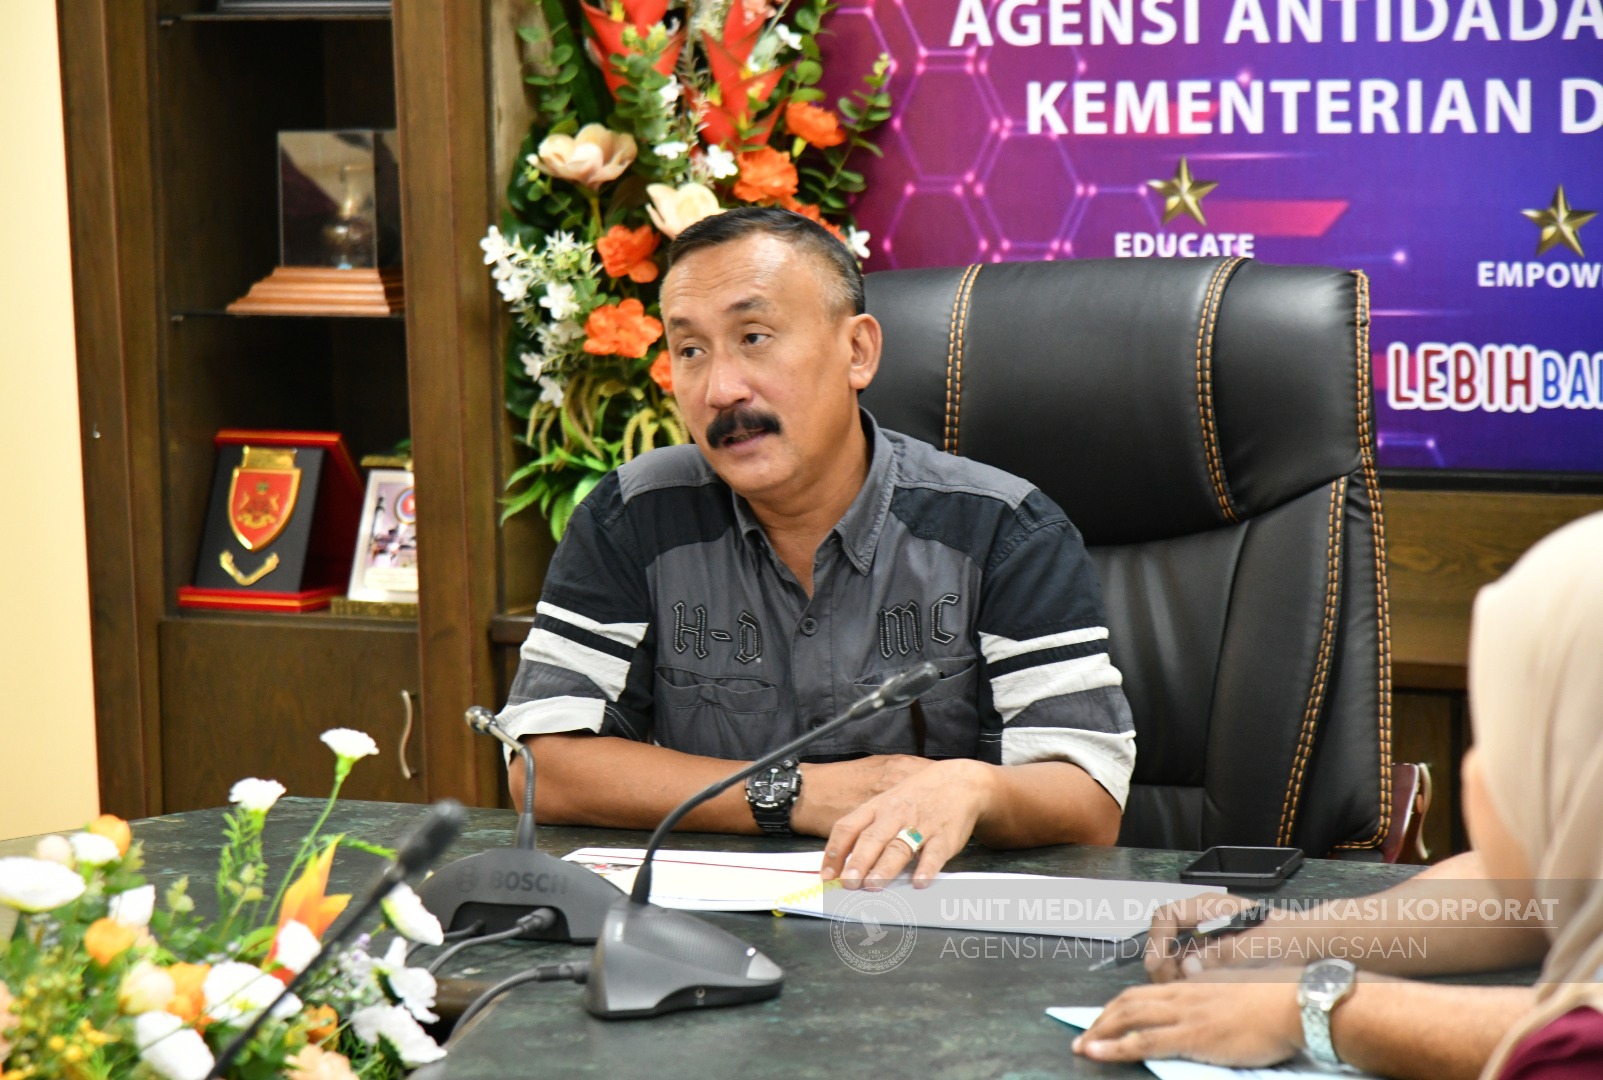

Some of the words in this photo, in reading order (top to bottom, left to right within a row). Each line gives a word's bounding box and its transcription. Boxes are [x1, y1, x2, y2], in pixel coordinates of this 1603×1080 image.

[948, 0, 1200, 46] AGENSI
[1223, 0, 1603, 44] ANTIDADA
[1026, 78, 1532, 135] KEMENTERIAN
[1114, 232, 1255, 259] EDUCATE
[1477, 261, 1603, 289] EMPOW
[1387, 341, 1603, 414] LEBIHBA
[489, 870, 569, 895] BOSCH
